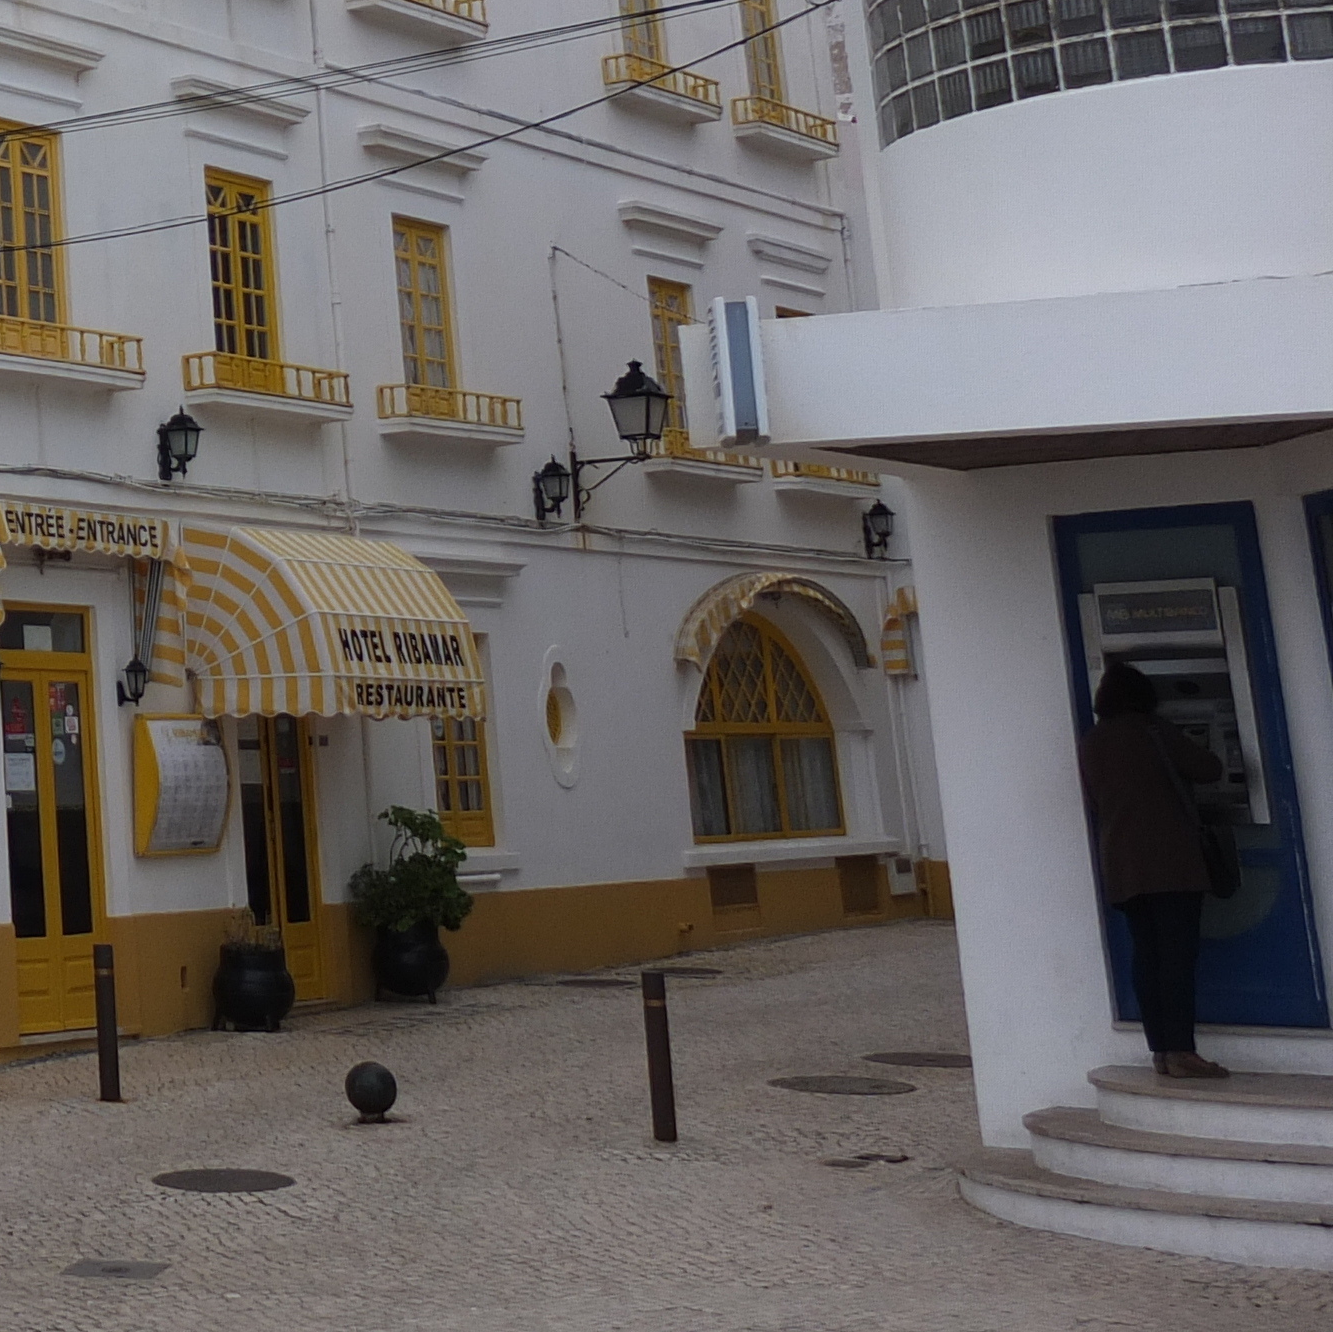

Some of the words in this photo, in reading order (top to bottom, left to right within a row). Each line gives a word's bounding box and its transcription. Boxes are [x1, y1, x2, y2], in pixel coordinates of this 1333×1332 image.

[4, 508, 65, 539] ENTRÉE
[76, 517, 159, 548] ENTRANCE
[338, 628, 392, 664] HOTEL
[393, 631, 465, 667] RIBAMAR
[355, 683, 467, 709] RESTAURANTE
